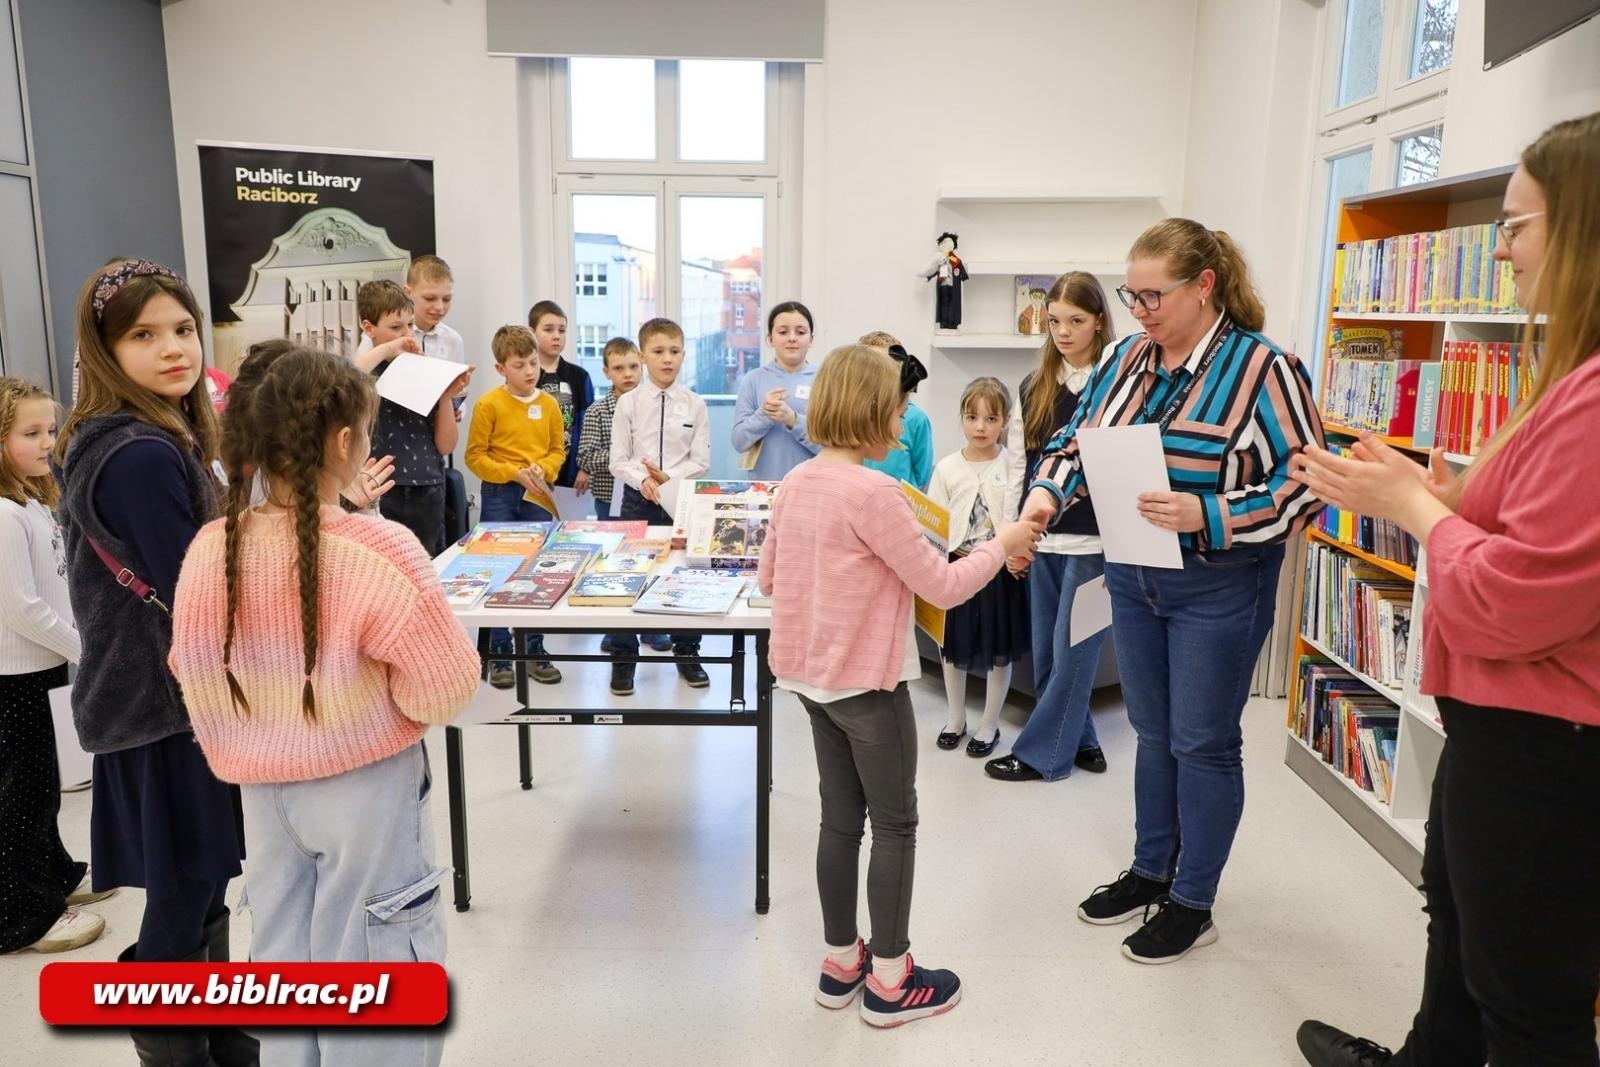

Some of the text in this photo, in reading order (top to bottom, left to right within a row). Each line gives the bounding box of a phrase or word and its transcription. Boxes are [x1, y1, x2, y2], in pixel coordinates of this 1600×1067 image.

[235, 167, 362, 192] Public Library
[236, 186, 319, 205] Raciborz
[1350, 344, 1380, 355] TOMEK
[1421, 378, 1436, 433] KOMIKSY
